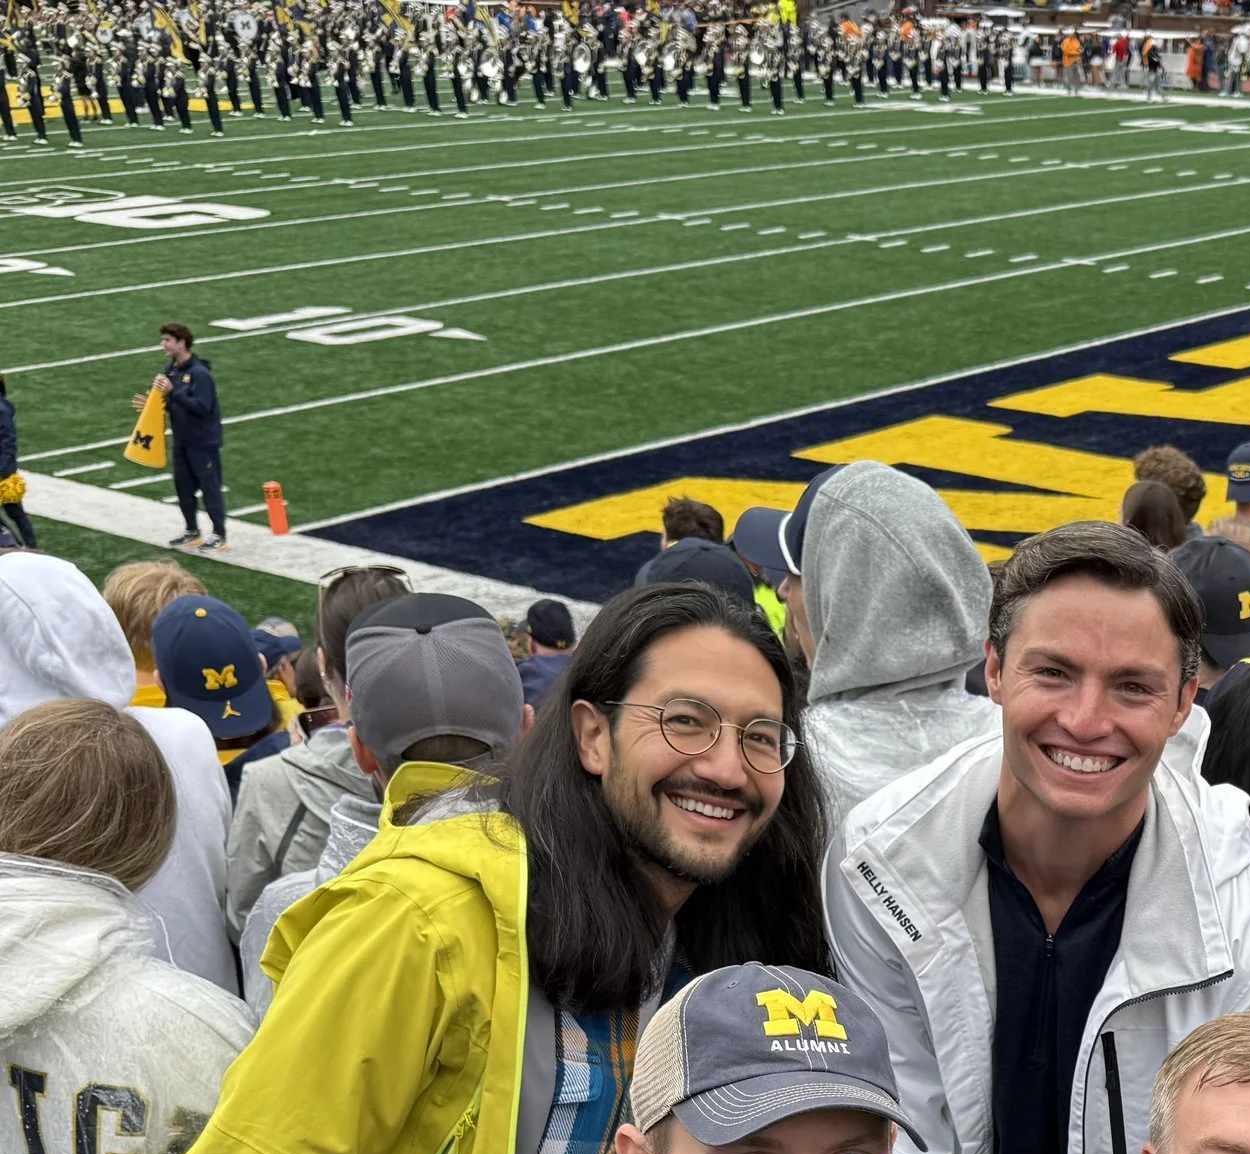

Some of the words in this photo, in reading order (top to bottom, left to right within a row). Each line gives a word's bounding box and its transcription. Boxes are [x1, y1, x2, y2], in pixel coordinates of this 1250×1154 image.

[133, 430, 154, 450] M
[202, 664, 238, 690] M
[856, 861, 888, 896] HELLY
[882, 895, 922, 942] HANSEN
[756, 988, 848, 1041] M
[770, 1039, 851, 1055] ALUMNI
